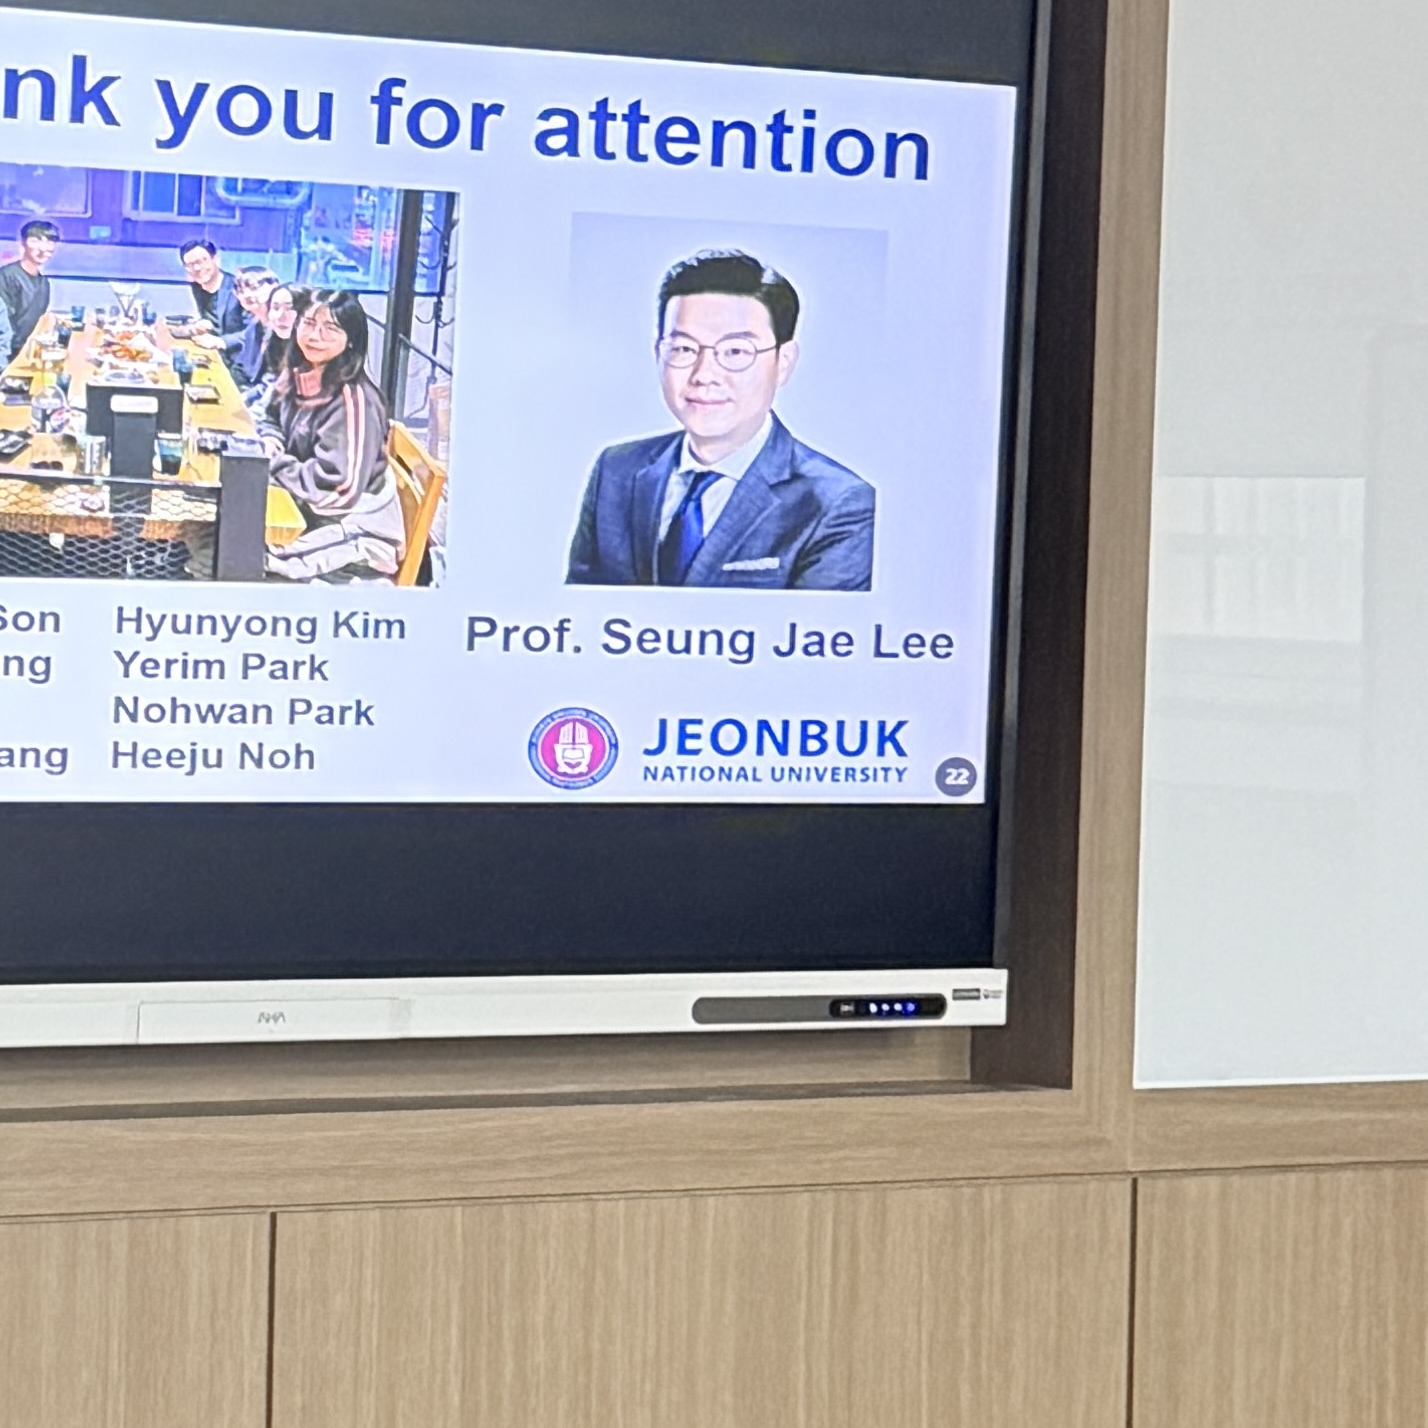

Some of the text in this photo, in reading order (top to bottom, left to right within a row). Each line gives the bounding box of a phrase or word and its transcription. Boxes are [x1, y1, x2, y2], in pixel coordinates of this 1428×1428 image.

[154, 77, 334, 150] you
[371, 77, 505, 152] for
[534, 96, 931, 182] attention
[115, 606, 407, 643] Hyunyong Kim
[466, 616, 956, 665] Prof. Seung Jae Lee
[114, 649, 330, 683] Yerim Park
[112, 695, 377, 728] Nohwan Park
[642, 718, 910, 759] JEONBUK
[110, 741, 316, 775] Heeju Noh
[643, 766, 909, 783] NATIONAL UNIVERSITY
